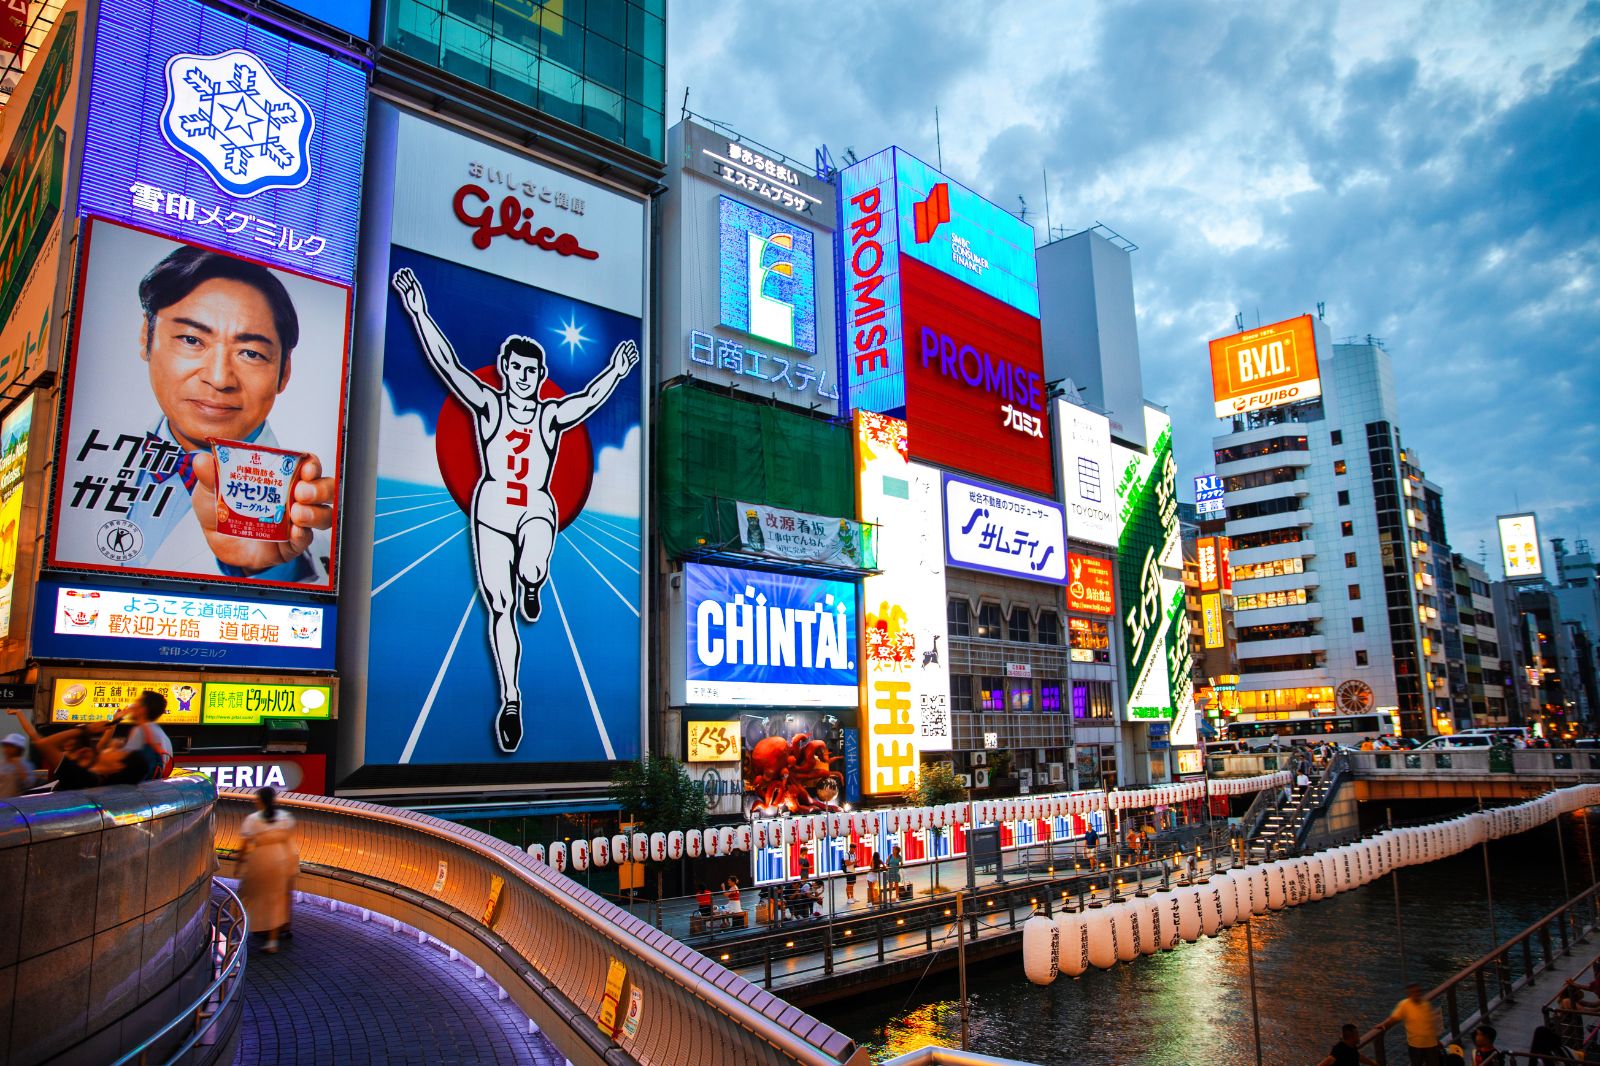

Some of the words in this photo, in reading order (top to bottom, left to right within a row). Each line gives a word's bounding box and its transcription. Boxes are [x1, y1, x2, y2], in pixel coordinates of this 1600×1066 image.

[728, 143, 799, 186] 夢ある住まい
[468, 161, 586, 217] おいしさと健康
[129, 180, 327, 258] 雪印メグミルク
[453, 183, 600, 261] Glico
[951, 232, 971, 249] SMBC
[951, 243, 990, 270] CONSUMER
[952, 252, 983, 275] FINANCE
[850, 186, 889, 376] PROMISE
[690, 329, 840, 401] 日商エステム
[920, 325, 1042, 412] PROMISE
[1237, 340, 1292, 383] B.V.D.
[1248, 387, 1300, 407] FUJIBO
[1000, 404, 1044, 439] プロミス
[75, 428, 181, 474] トクホ
[116, 468, 135, 480] の
[504, 427, 533, 508] グリコ
[70, 474, 175, 518] ガセリ
[235, 501, 271, 514] ヨーグルト
[969, 491, 1049, 519] 総合不動産のプロデューサー
[765, 512, 827, 537] 改源看板
[1071, 502, 1113, 523] TOYOTOMI
[978, 522, 1040, 559] サムティ
[123, 596, 268, 620] ようこそ道頓堀へ
[108, 614, 201, 639] 歡迎光臨
[219, 621, 281, 643] 道頓堀
[158, 646, 228, 659] 雪印メグミルク
[209, 691, 244, 709] 賃貸・売買
[245, 688, 296, 712] ピタットハウス
[698, 726, 731, 756] くくる
[838, 728, 845, 750] 2F
[873, 680, 915, 794] 玉出
[182, 765, 286, 787] TERIA
